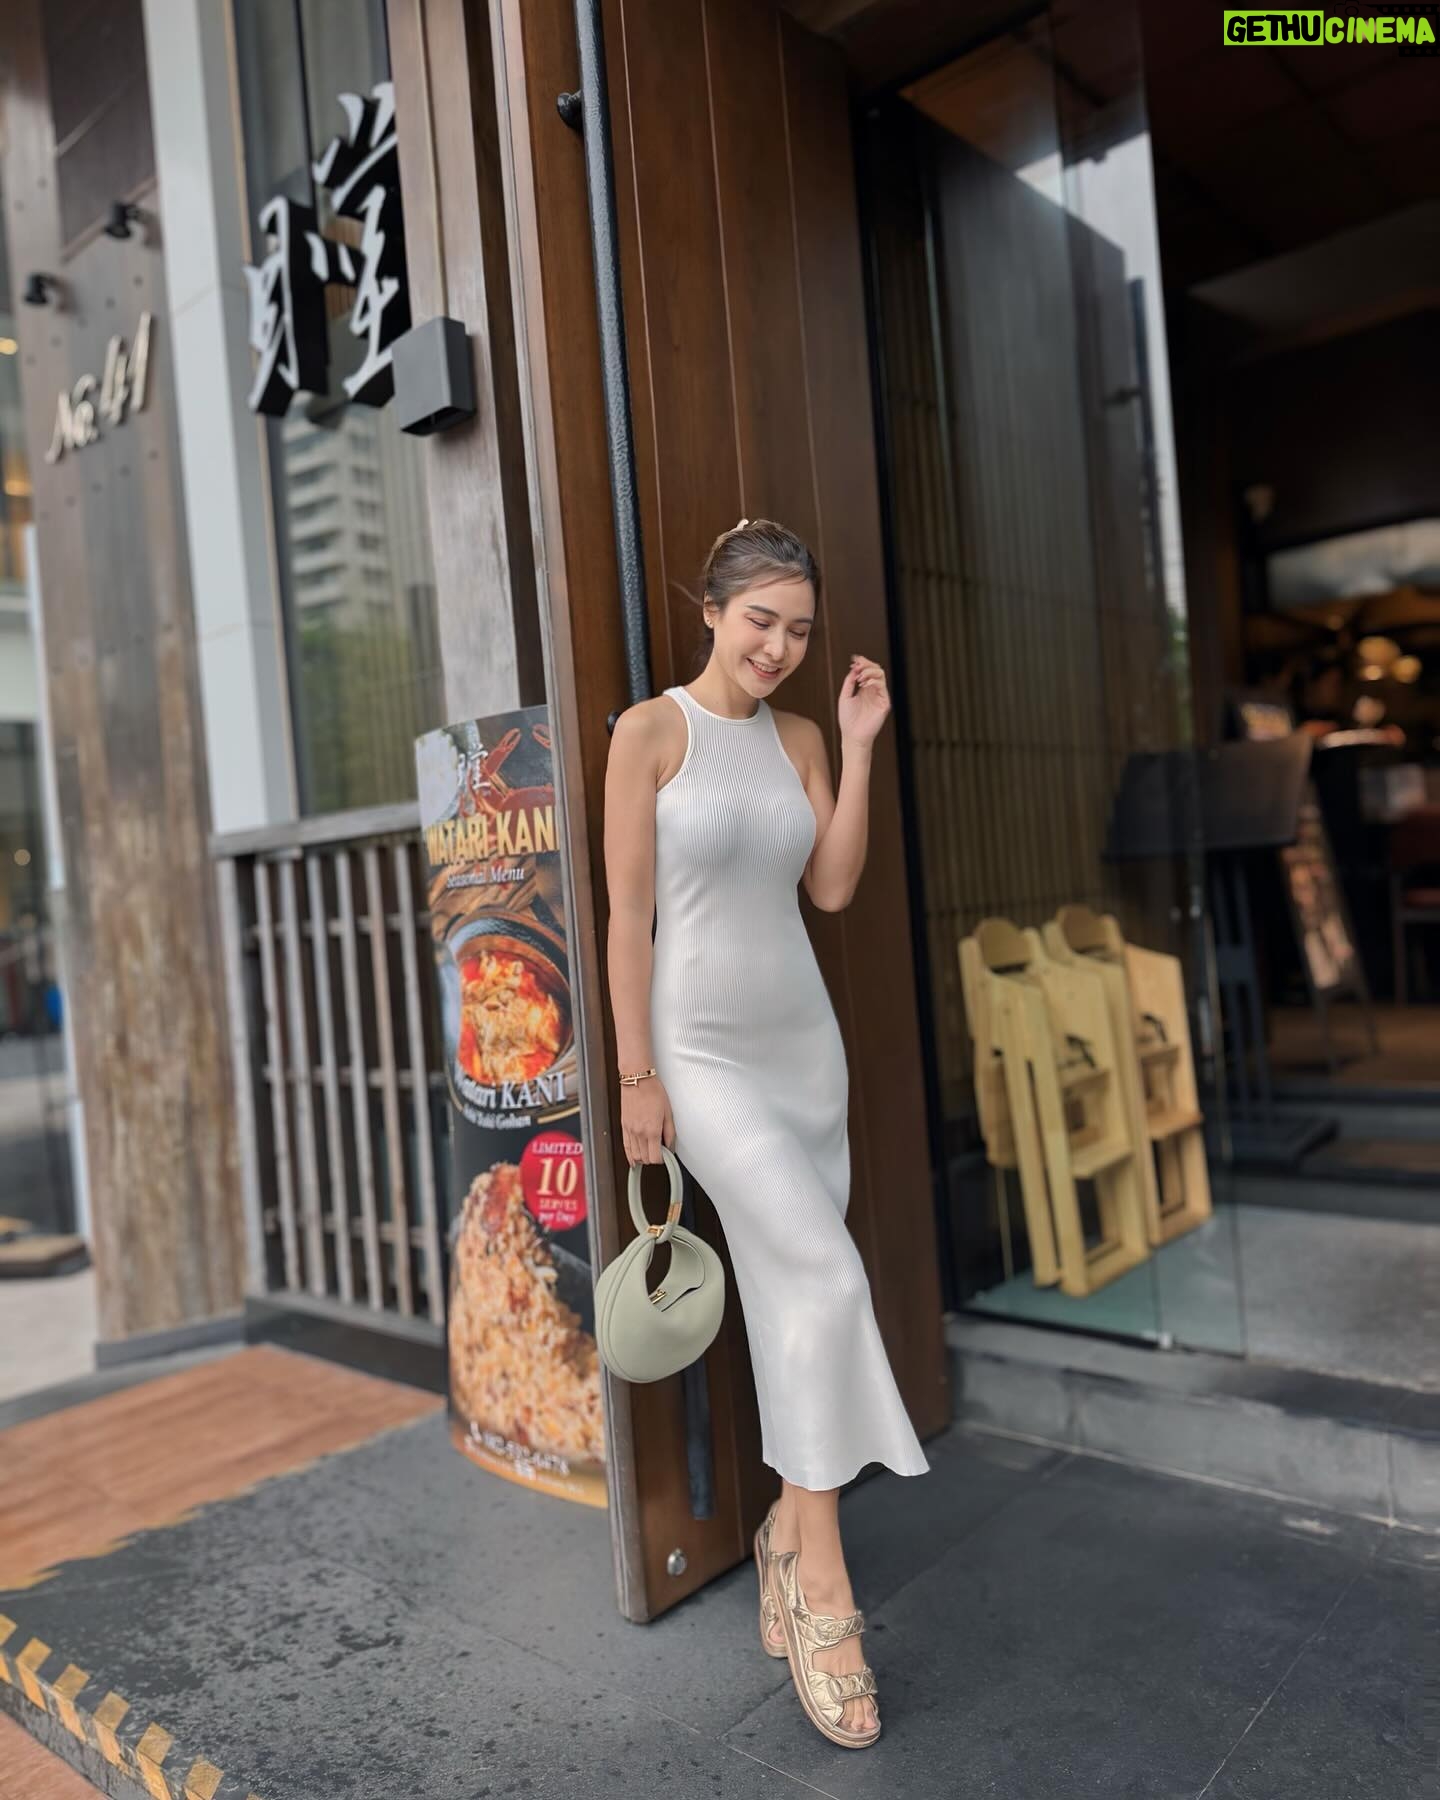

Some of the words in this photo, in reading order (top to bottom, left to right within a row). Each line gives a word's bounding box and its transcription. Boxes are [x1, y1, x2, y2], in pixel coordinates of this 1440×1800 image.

[490, 865, 525, 882] Menu
[501, 1071, 567, 1110] KANI
[531, 1142, 584, 1155] LIMITED
[535, 1157, 578, 1197] 10
